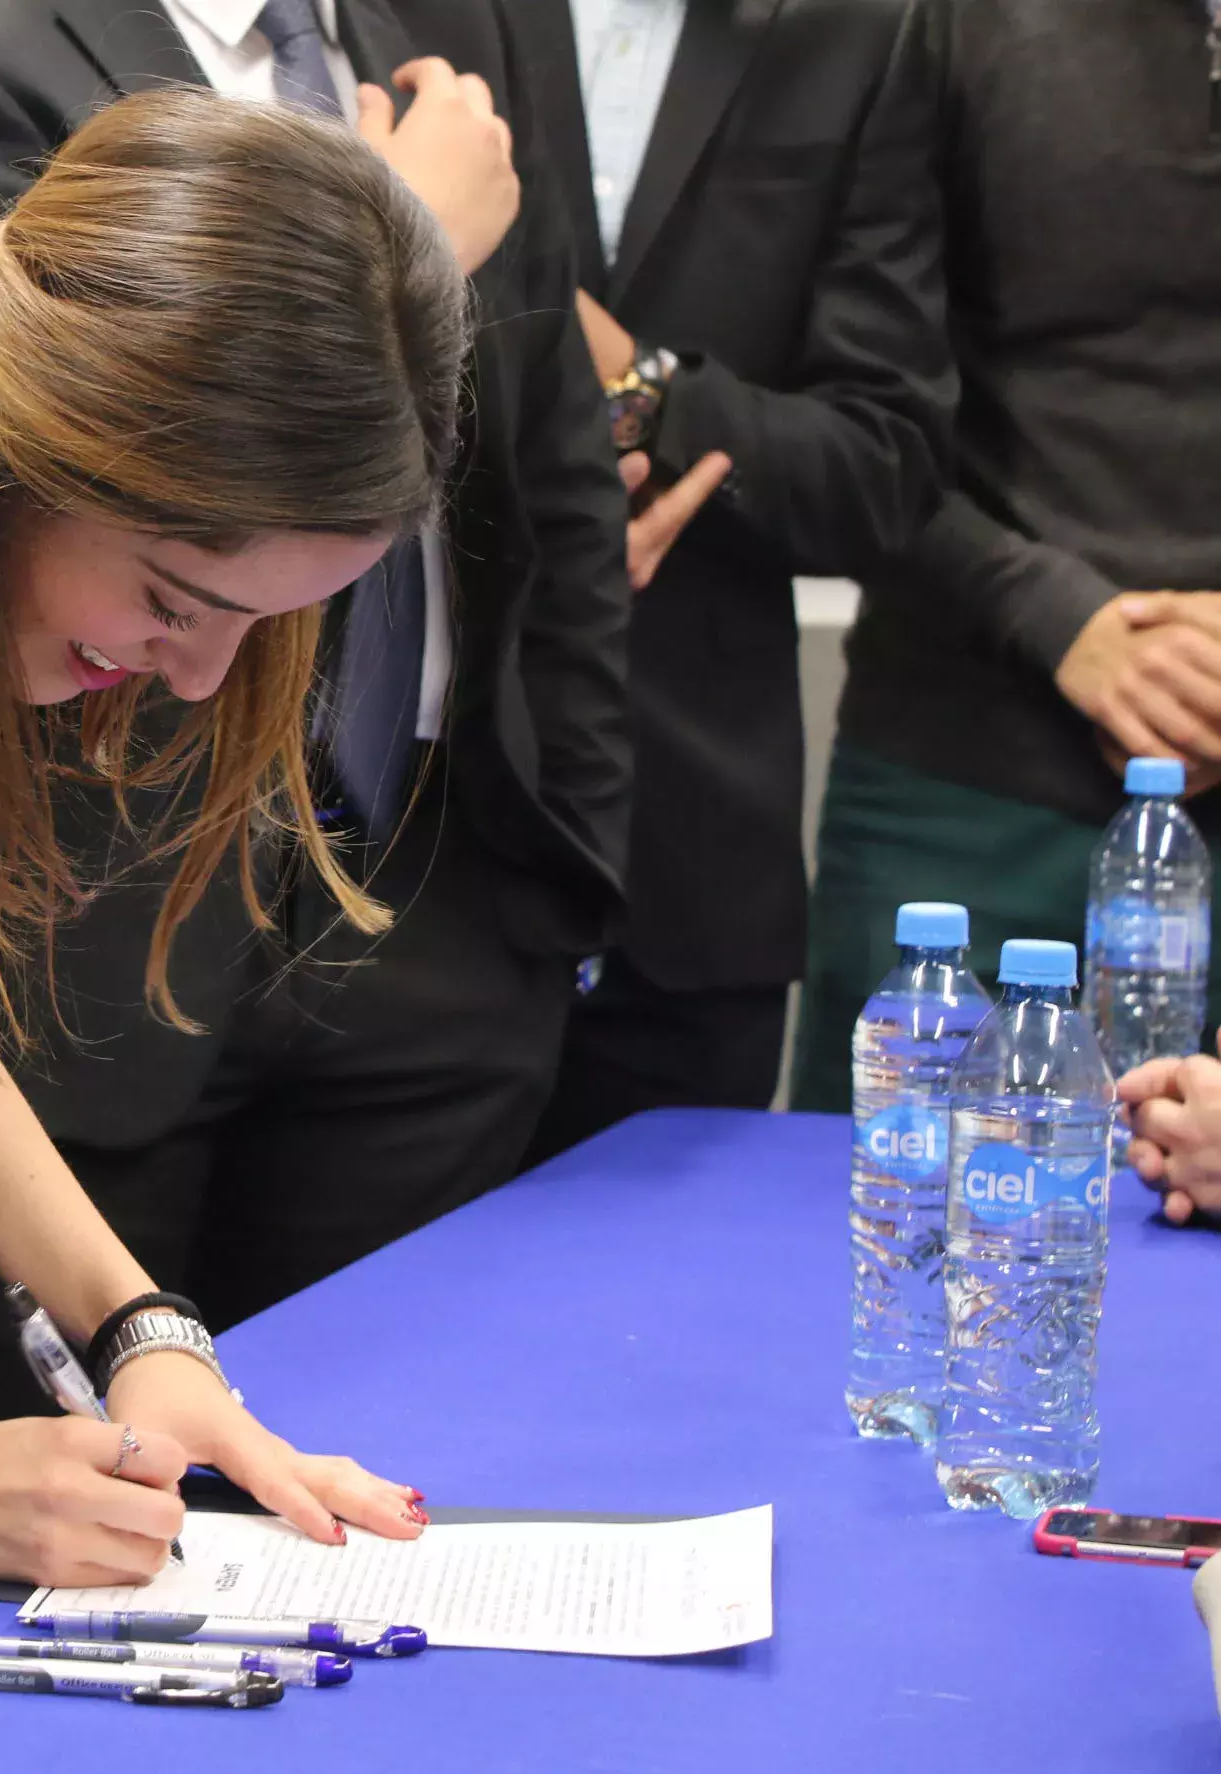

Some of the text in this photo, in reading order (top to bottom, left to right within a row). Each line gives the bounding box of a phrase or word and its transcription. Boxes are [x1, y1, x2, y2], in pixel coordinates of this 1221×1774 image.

[870, 1124, 935, 1160] ciel
[966, 1166, 1036, 1205] ciel
[72, 1646, 99, 1657] Roller
[100, 1648, 117, 1658] Ball
[17, 1675, 36, 1686] Ball
